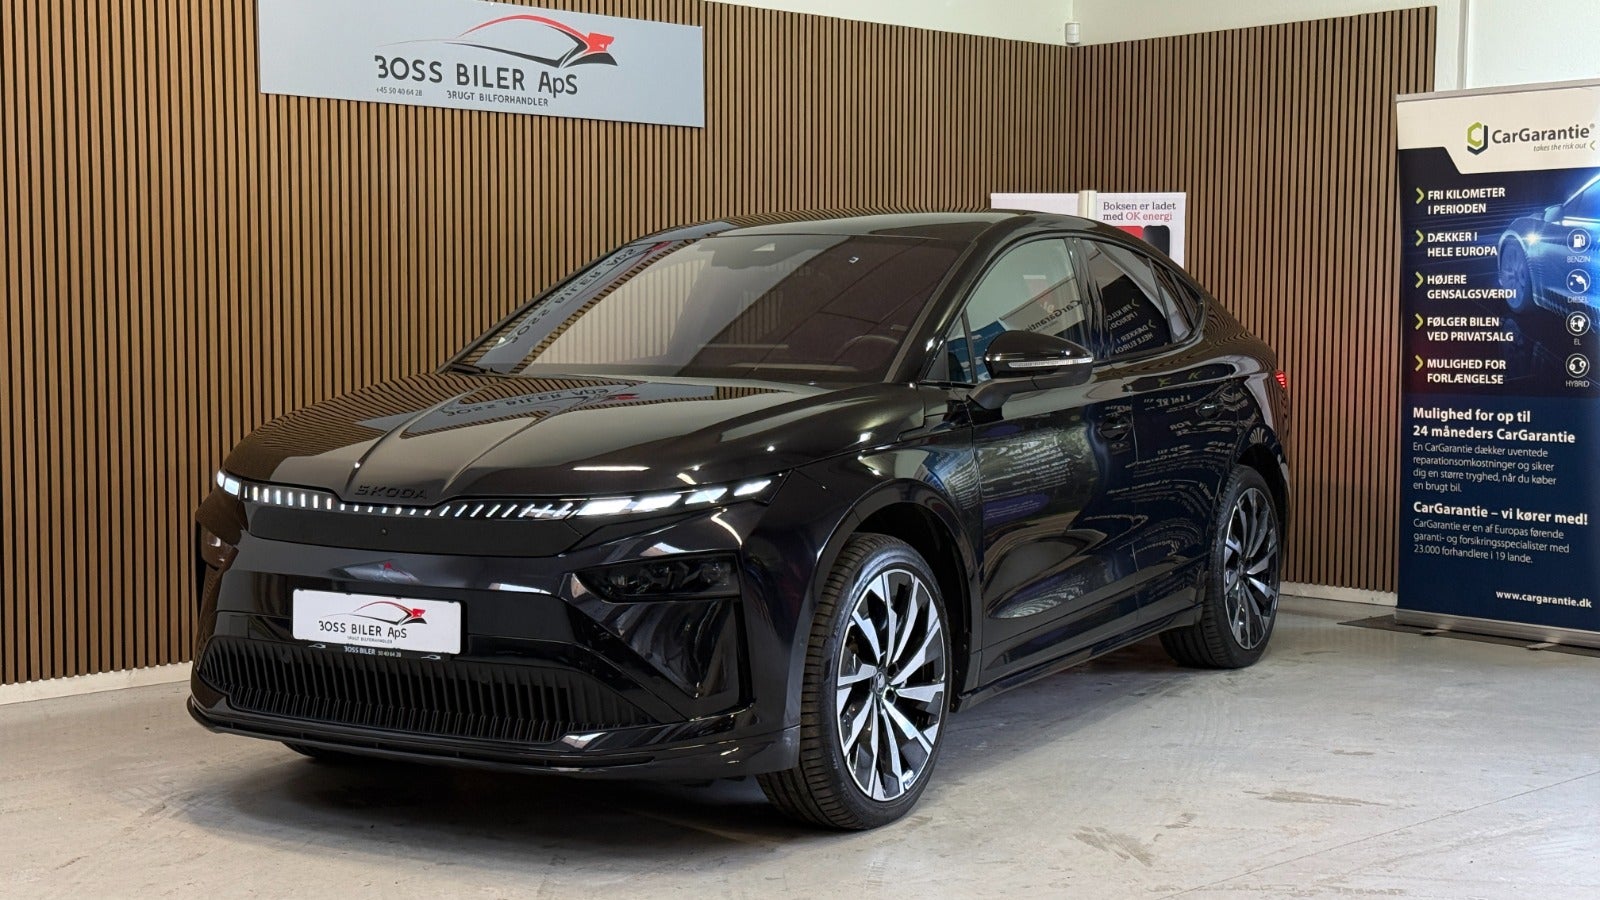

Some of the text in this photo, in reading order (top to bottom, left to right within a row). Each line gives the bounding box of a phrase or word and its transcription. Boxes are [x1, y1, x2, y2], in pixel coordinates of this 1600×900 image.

[457, 63, 525, 91] BILER
[538, 71, 578, 98] ApS
[480, 93, 548, 106] BILFORHANDLER
[1533, 144, 1549, 152] takes
[1551, 143, 1561, 151] the
[1427, 187, 1505, 200] FRI KILOMETER
[1103, 202, 1137, 210] Boksen
[1152, 202, 1176, 210] ladet
[1428, 203, 1486, 215] I PERIODEN
[1103, 212, 1173, 222] med OK energi
[1428, 232, 1477, 242] DÆKKER I
[1428, 246, 1498, 257] HELE EUROPA
[1428, 274, 1467, 285] HØJERE
[1427, 289, 1516, 299] GENSALGSVÆRDI
[1427, 317, 1500, 327] FØLGER BILEN
[1427, 332, 1514, 342] VED PRIVATSALG
[1427, 359, 1506, 369] MULIGHED FOR
[1428, 374, 1504, 384] FORLÆNGELSE
[1566, 380, 1589, 388] HYBRID
[1413, 408, 1530, 424] Mulighed for op til
[1413, 425, 1575, 443] 24 måneders CarGarantie
[1413, 442, 1548, 457] En CarGarantie dækker uventede
[1413, 456, 1554, 472] reparationsomkostninger og sikrer
[1413, 468, 1426, 479] dig
[1441, 471, 1463, 479] større
[1466, 472, 1500, 482] tryghed,
[1502, 473, 1516, 483] når
[1518, 474, 1529, 483] du
[1532, 474, 1556, 484] køber
[1413, 481, 1462, 493] en brugt bil.
[1413, 502, 1488, 517] CarGarantie
[1501, 508, 1512, 519] vi
[1516, 508, 1551, 522] kører
[1555, 513, 1588, 525] med!
[1413, 519, 1460, 530] CarGarantie
[1485, 524, 1493, 533] af
[1495, 524, 1528, 536] Europas
[1530, 527, 1564, 539] førende
[1413, 533, 1569, 553] garanti- og forsikringsspecialister med
[1414, 544, 1440, 554] 23.000
[1442, 546, 1488, 559] forhandlere
[1496, 551, 1505, 559] 19
[1508, 552, 1533, 563] lande.
[1496, 591, 1592, 608] www.cargarantie.dk
[351, 624, 382, 636] BILER
[388, 627, 407, 639] ApS
